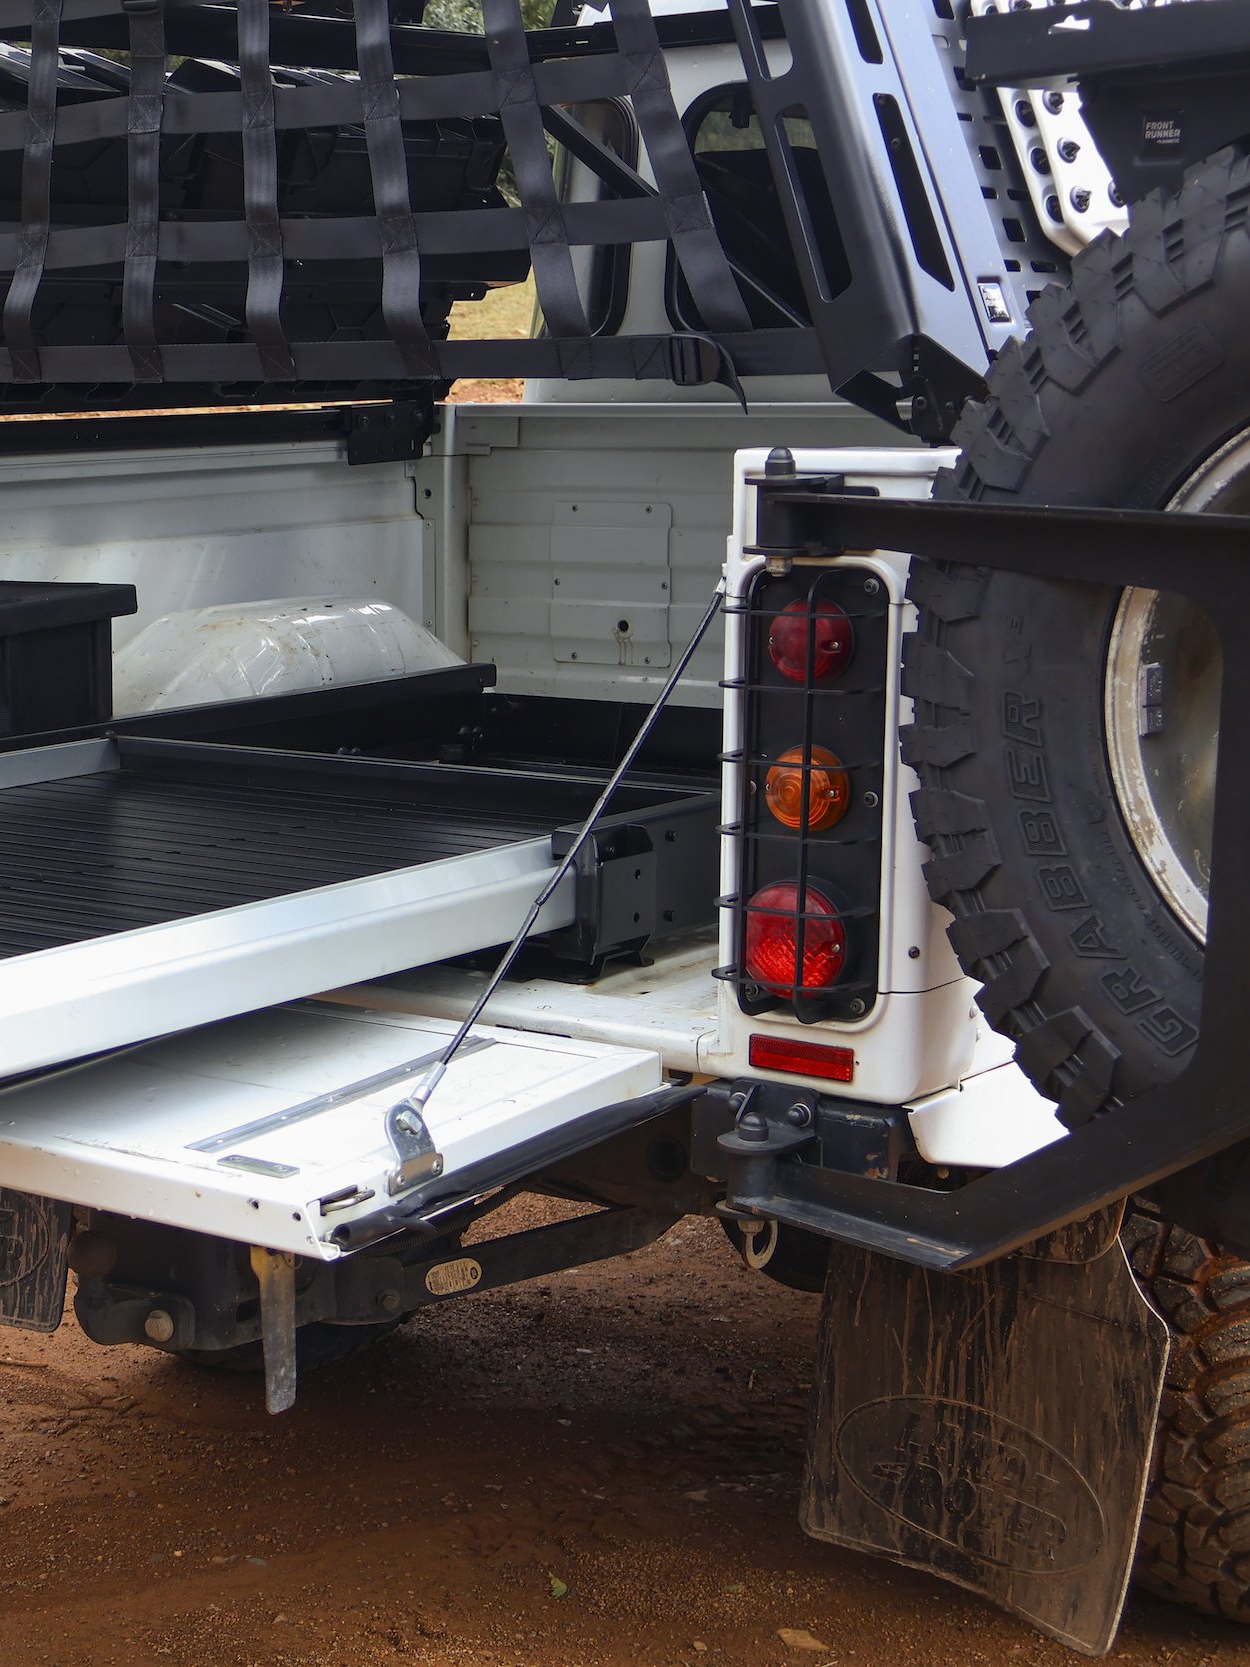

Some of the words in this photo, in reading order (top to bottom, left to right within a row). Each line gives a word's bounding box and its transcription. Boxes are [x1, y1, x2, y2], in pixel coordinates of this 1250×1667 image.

[1146, 120, 1174, 130] FRONT
[1145, 128, 1181, 139] RUNNER
[1004, 691, 1199, 1056] GRABBER
